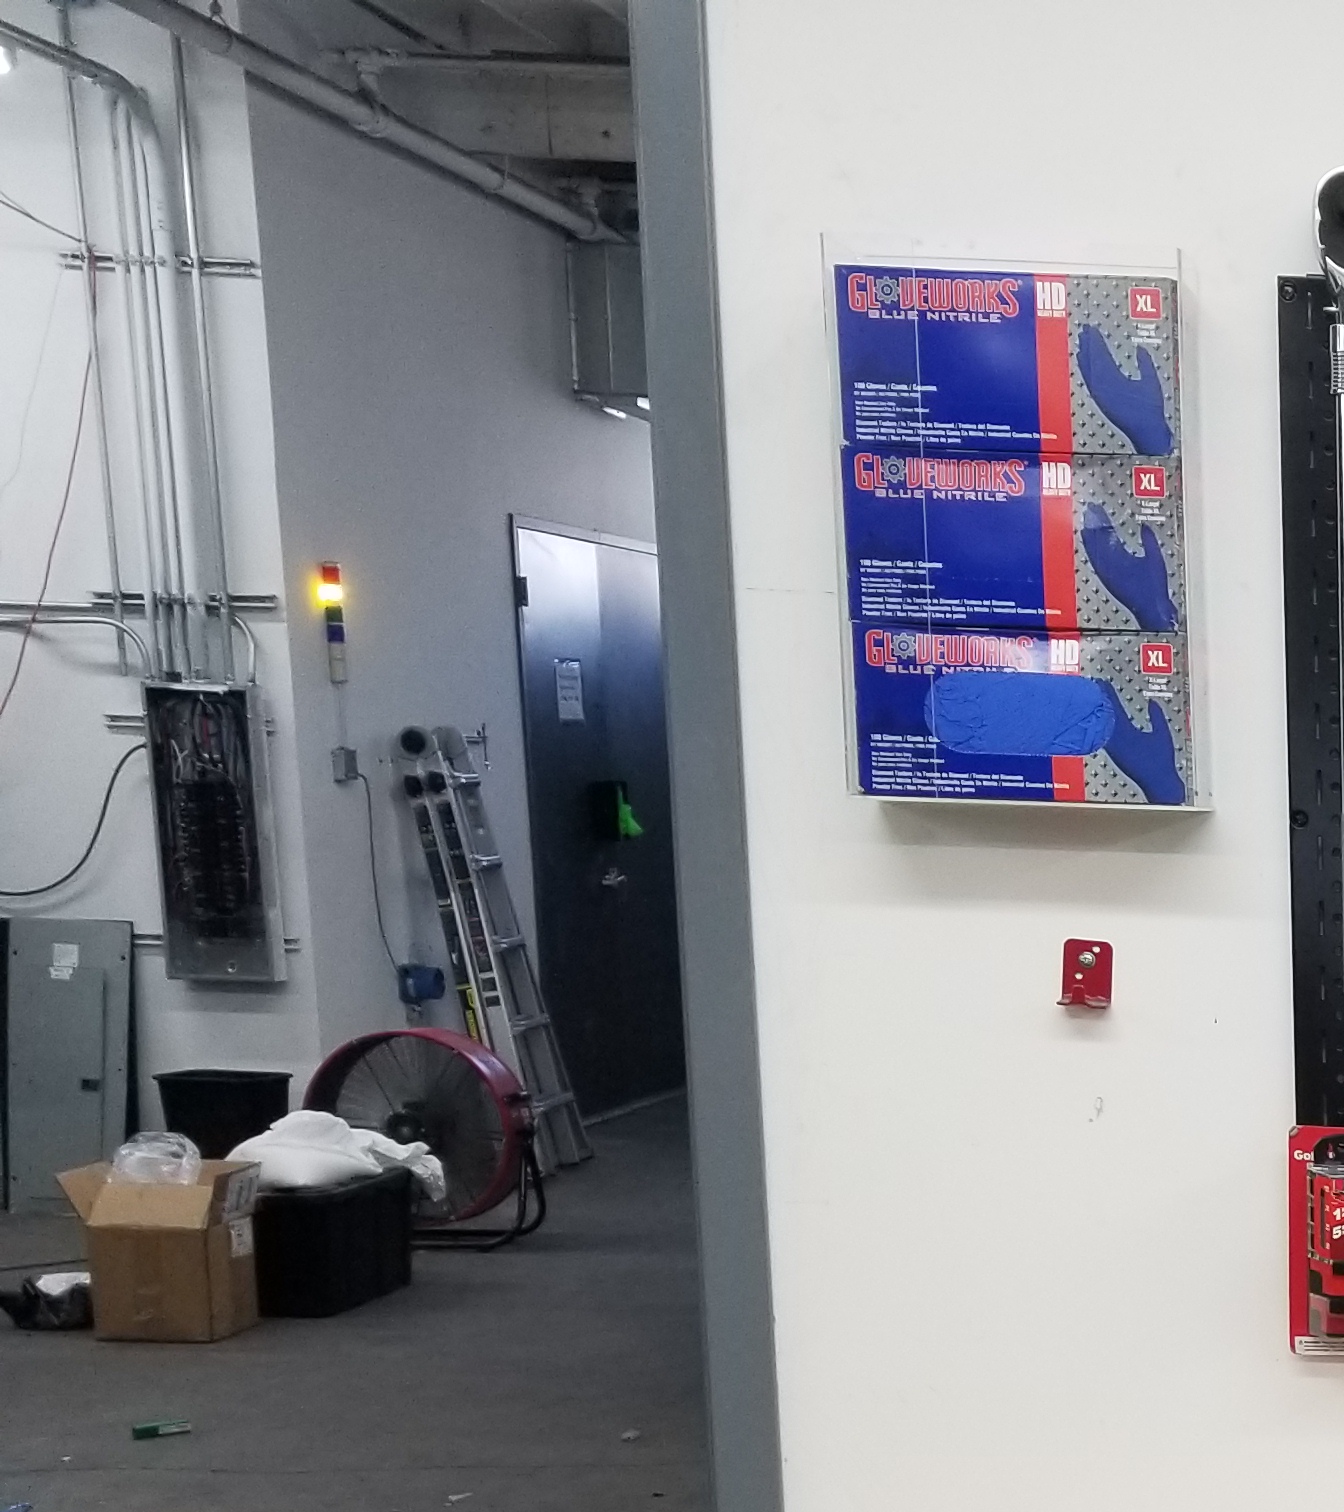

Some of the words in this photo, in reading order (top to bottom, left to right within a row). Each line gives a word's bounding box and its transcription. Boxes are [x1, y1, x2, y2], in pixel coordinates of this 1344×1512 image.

[1036, 281, 1066, 310] HD
[1135, 294, 1157, 313] XL
[867, 309, 919, 320] BLUE
[926, 311, 1002, 323] NITRILE
[1042, 461, 1072, 489] HD
[1139, 473, 1161, 492] XL
[874, 488, 925, 499] BLUE
[932, 490, 1008, 502] NITRILE
[1050, 638, 1079, 665] HD
[1147, 650, 1168, 668] XL
[885, 664, 936, 675] BLUE
